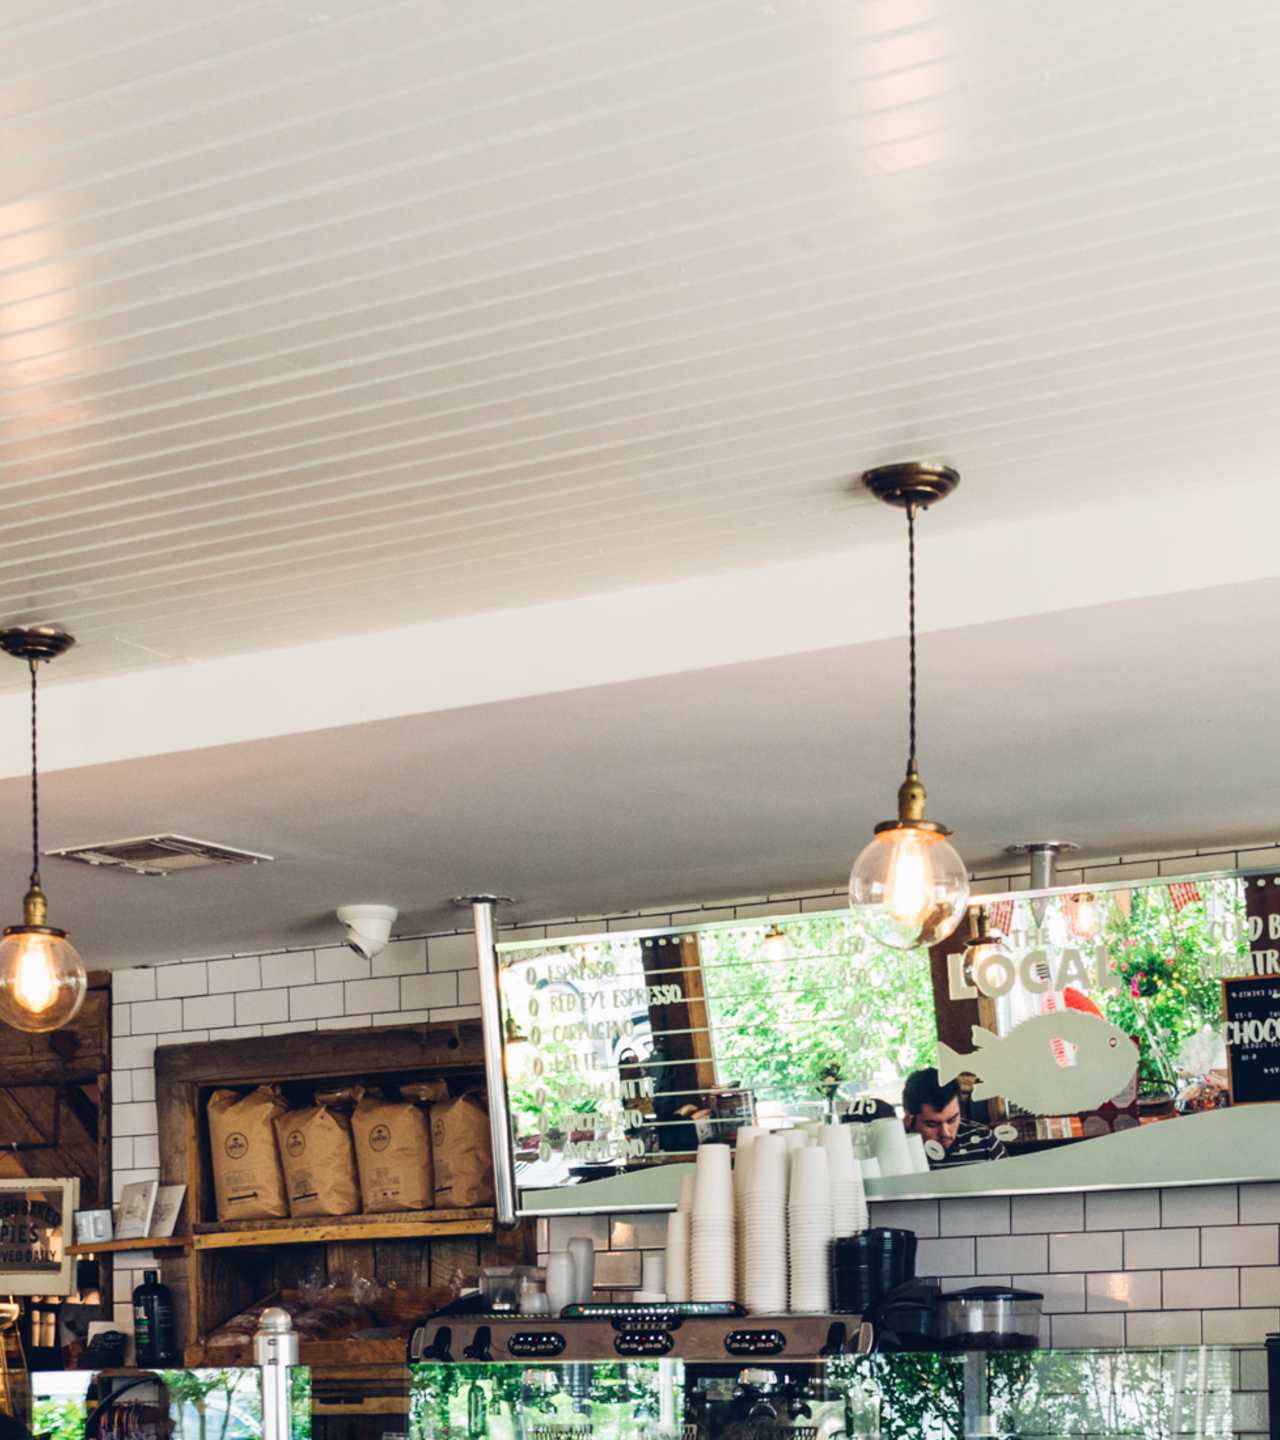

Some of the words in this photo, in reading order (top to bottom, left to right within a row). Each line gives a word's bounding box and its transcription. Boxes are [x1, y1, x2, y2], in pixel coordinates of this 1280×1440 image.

[1012, 927, 1052, 947] THE
[946, 943, 1123, 1002] LOCAL
[550, 993, 576, 1012] RED
[614, 984, 682, 1008] ESPRESSO
[0, 1225, 39, 1244] PIES
